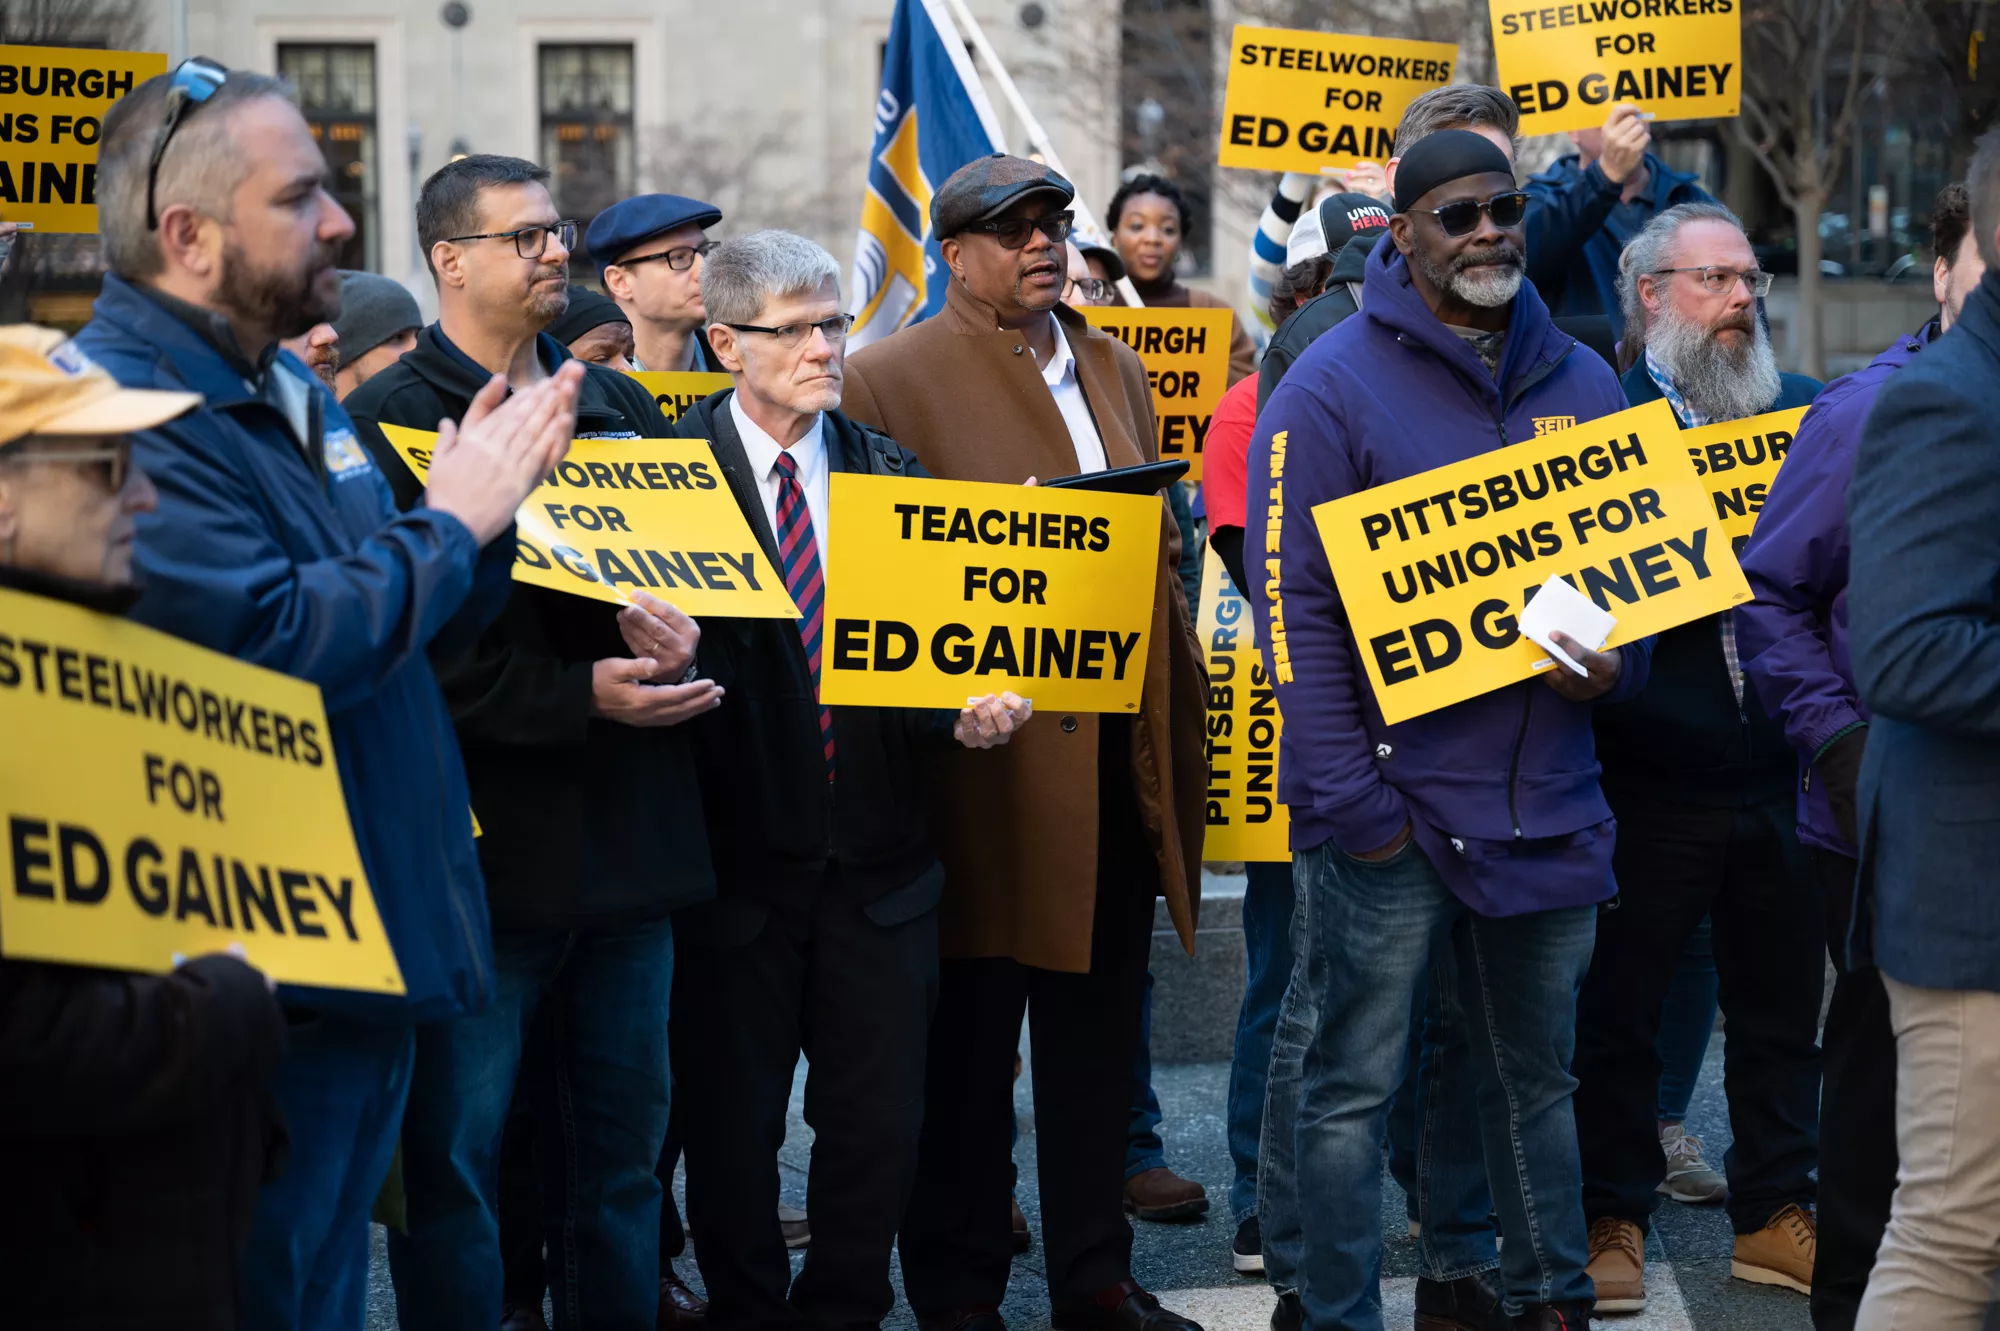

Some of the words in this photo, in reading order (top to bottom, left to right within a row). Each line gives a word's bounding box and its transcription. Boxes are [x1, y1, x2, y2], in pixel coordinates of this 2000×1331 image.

[1501, 0, 1734, 36] STEELWORKERS
[1240, 44, 1451, 83] STEELWORKERS
[1595, 32, 1656, 57] FOR
[1324, 88, 1383, 112] FOR
[1510, 80, 1569, 115] ED
[1577, 63, 1733, 105] GAINEY
[1230, 114, 1289, 149] ED
[1157, 415, 1213, 454] EY
[1270, 430, 1288, 478] WIN
[1266, 481, 1284, 553] THE
[1361, 432, 1648, 551] PITTSBURGH
[544, 503, 633, 533] FOR
[894, 503, 1110, 552] TEACHERS
[551, 544, 764, 592] GAINEY
[1382, 521, 1562, 603] UNIONS
[1569, 488, 1667, 545] FOR
[964, 566, 1048, 605] FOR
[1369, 618, 1463, 687] ED
[1470, 526, 1713, 650] GNEY
[1265, 558, 1294, 685] FUTURE
[833, 618, 919, 672] ED
[930, 622, 1141, 681] GAINEY
[0, 638, 325, 769] STEELWORKERS
[1205, 571, 1242, 825] PITTSBURGH
[1245, 663, 1276, 823] UNIONS
[143, 751, 227, 824] FOR
[8, 813, 112, 907] ED
[123, 836, 361, 944] GAINEY
